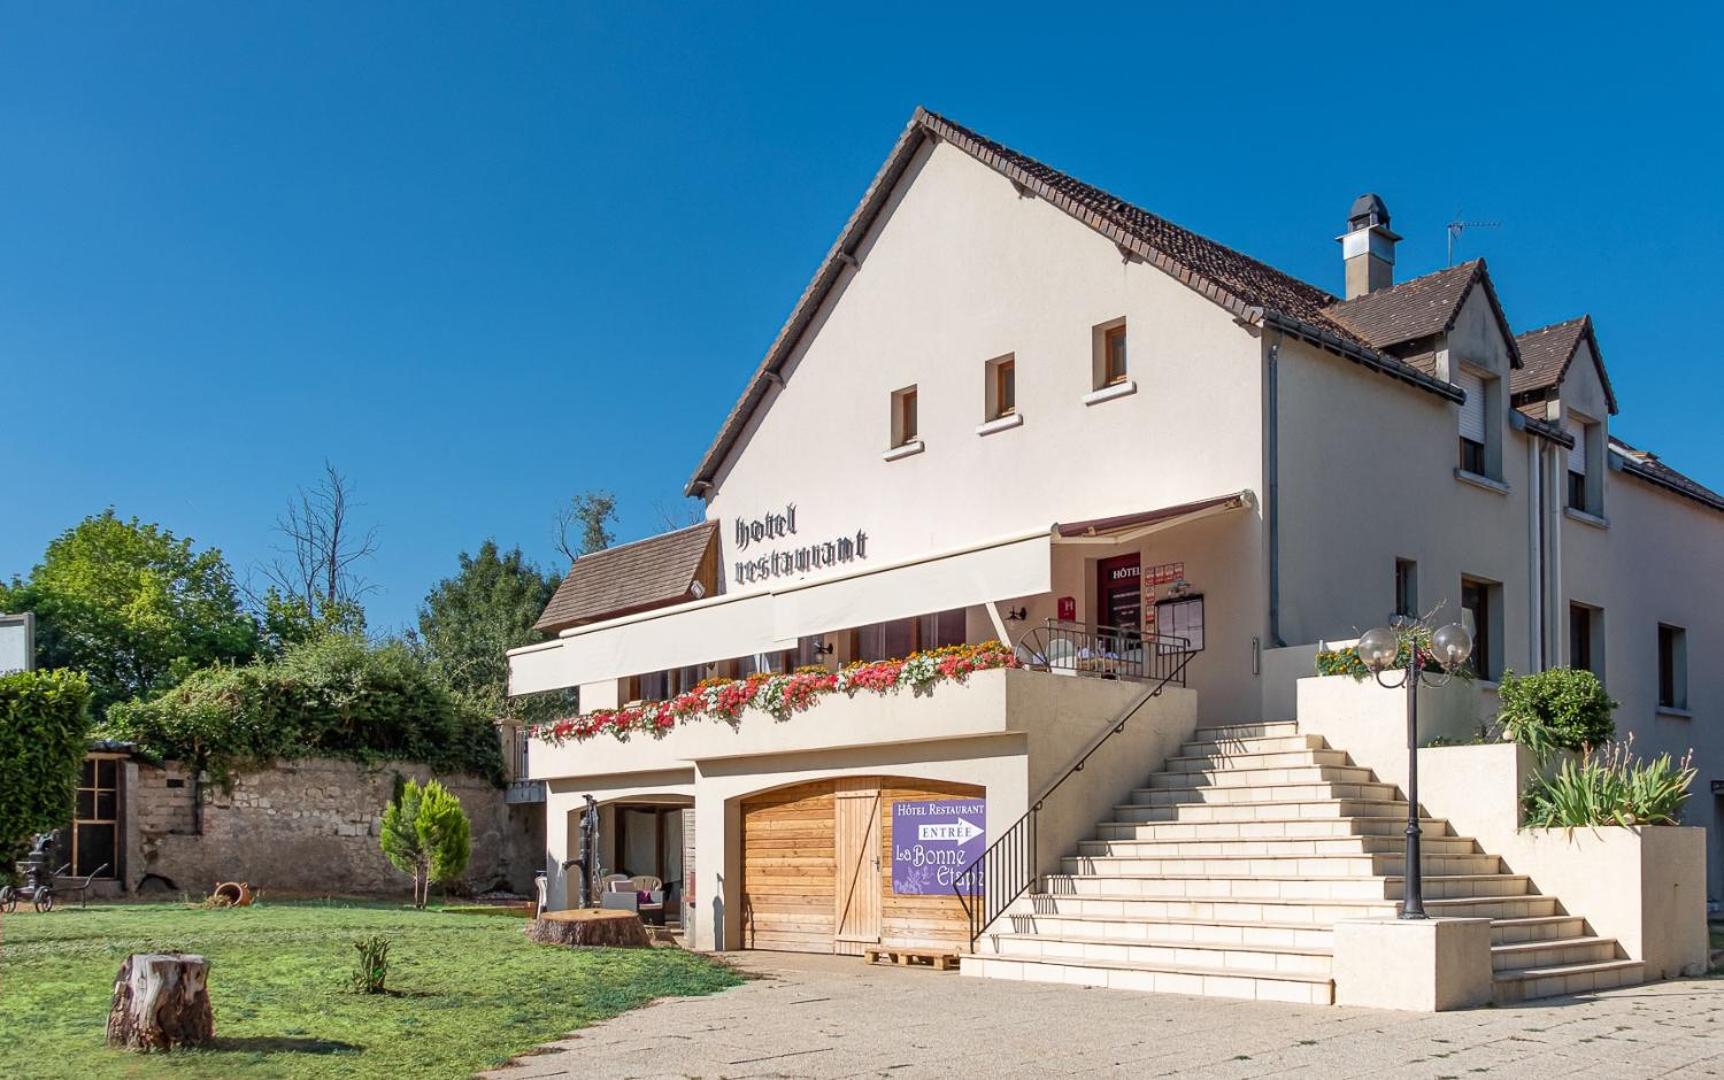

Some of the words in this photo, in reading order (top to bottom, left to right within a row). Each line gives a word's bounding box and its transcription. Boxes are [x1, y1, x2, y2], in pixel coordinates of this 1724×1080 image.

[735, 502, 797, 552] hotel
[734, 527, 869, 585] restaurant
[929, 803, 985, 816] RESTAURANT
[922, 822, 973, 839] ENTRÉE
[896, 844, 912, 861] La
[912, 844, 966, 867] Bonne
